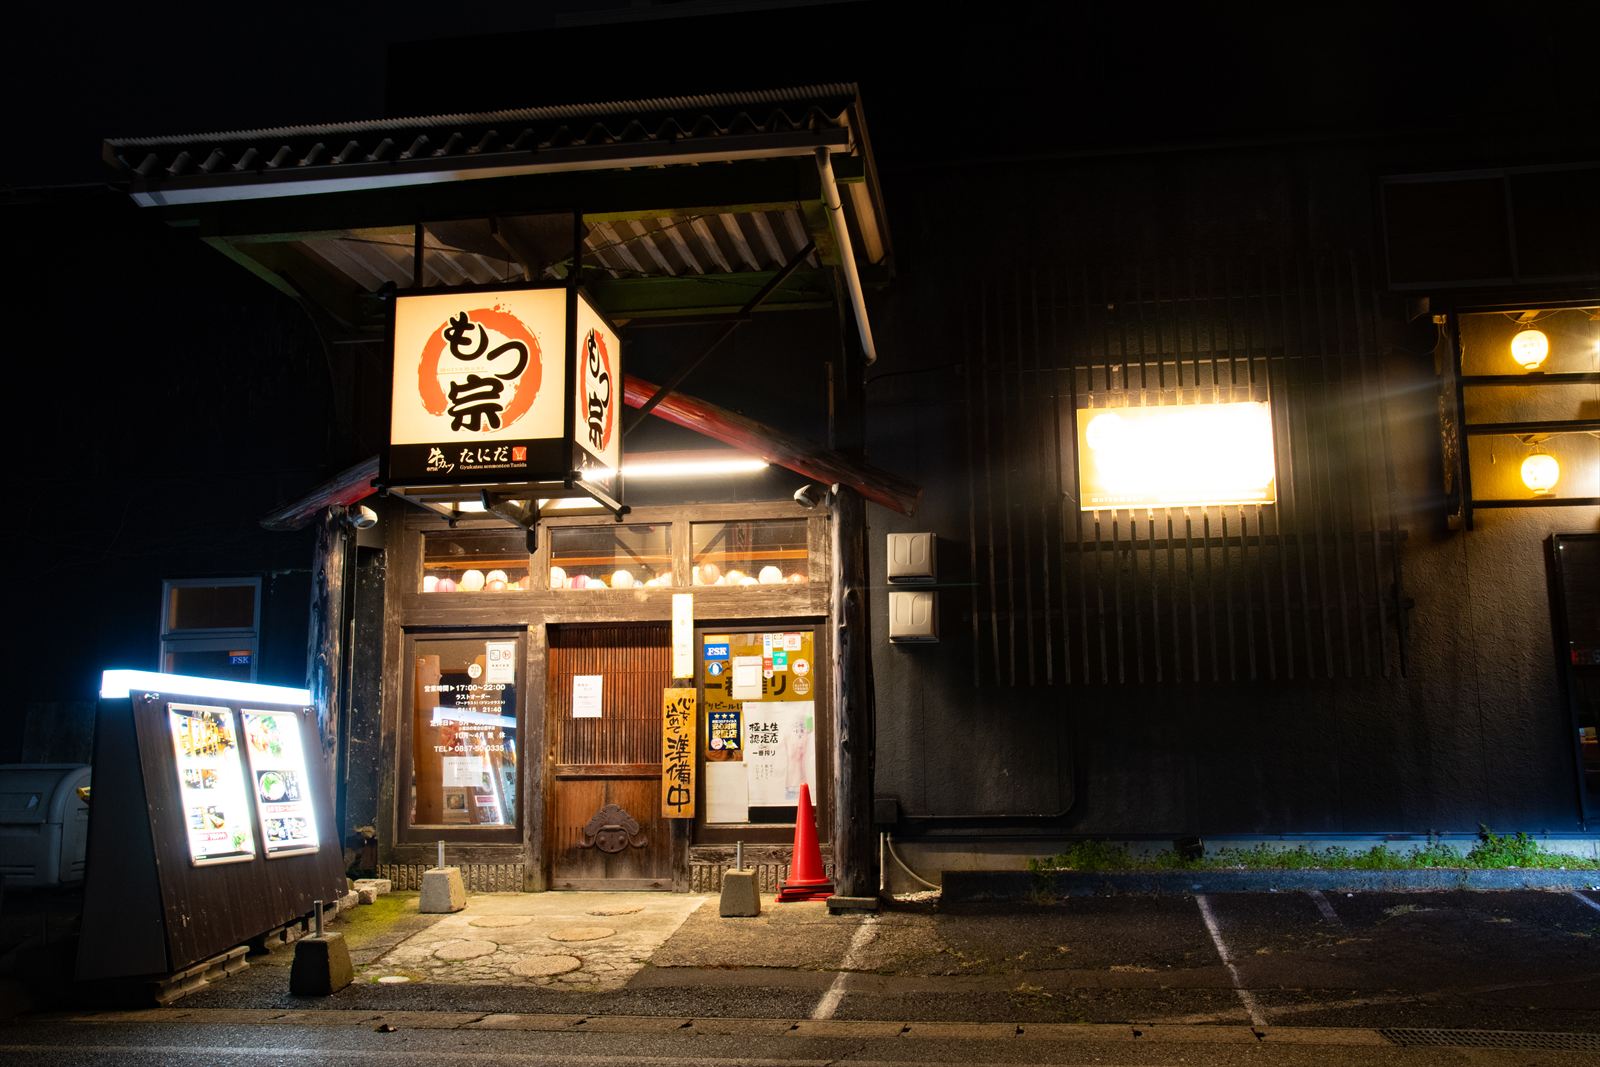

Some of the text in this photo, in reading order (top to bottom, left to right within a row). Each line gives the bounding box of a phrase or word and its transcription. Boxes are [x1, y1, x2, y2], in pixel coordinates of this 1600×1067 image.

[444, 311, 528, 432] もつ宗
[459, 446, 509, 463] たにだ
[707, 647, 727, 656] FSK
[232, 656, 249, 665] FSK
[748, 722, 779, 732] 極上生
[749, 733, 779, 744] 認定店
[664, 734, 692, 813] 準備中
